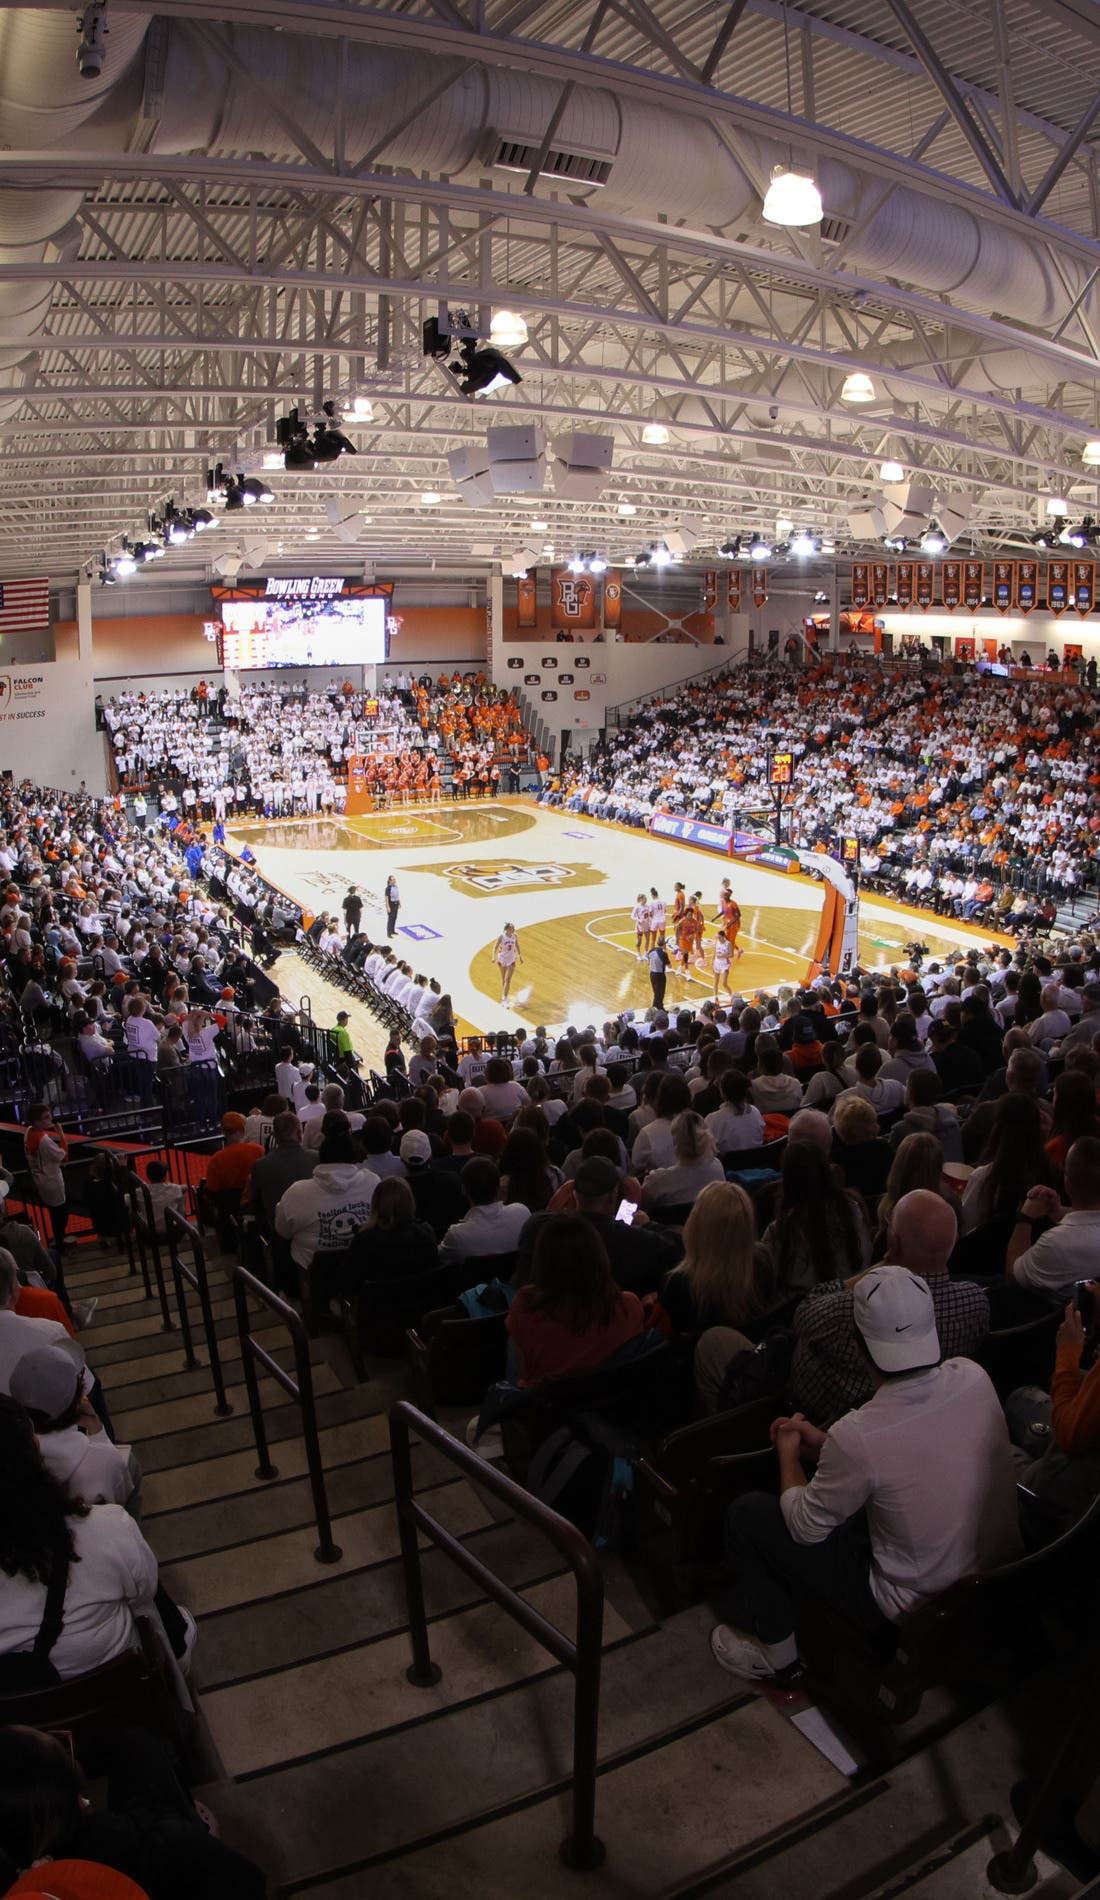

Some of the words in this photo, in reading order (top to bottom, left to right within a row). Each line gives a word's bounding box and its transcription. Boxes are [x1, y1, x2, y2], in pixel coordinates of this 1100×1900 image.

[265, 577, 311, 595] BOWLING
[310, 576, 345, 594] GREEN
[16, 710, 46, 719] SUCCESS
[772, 765, 789, 782] 20
